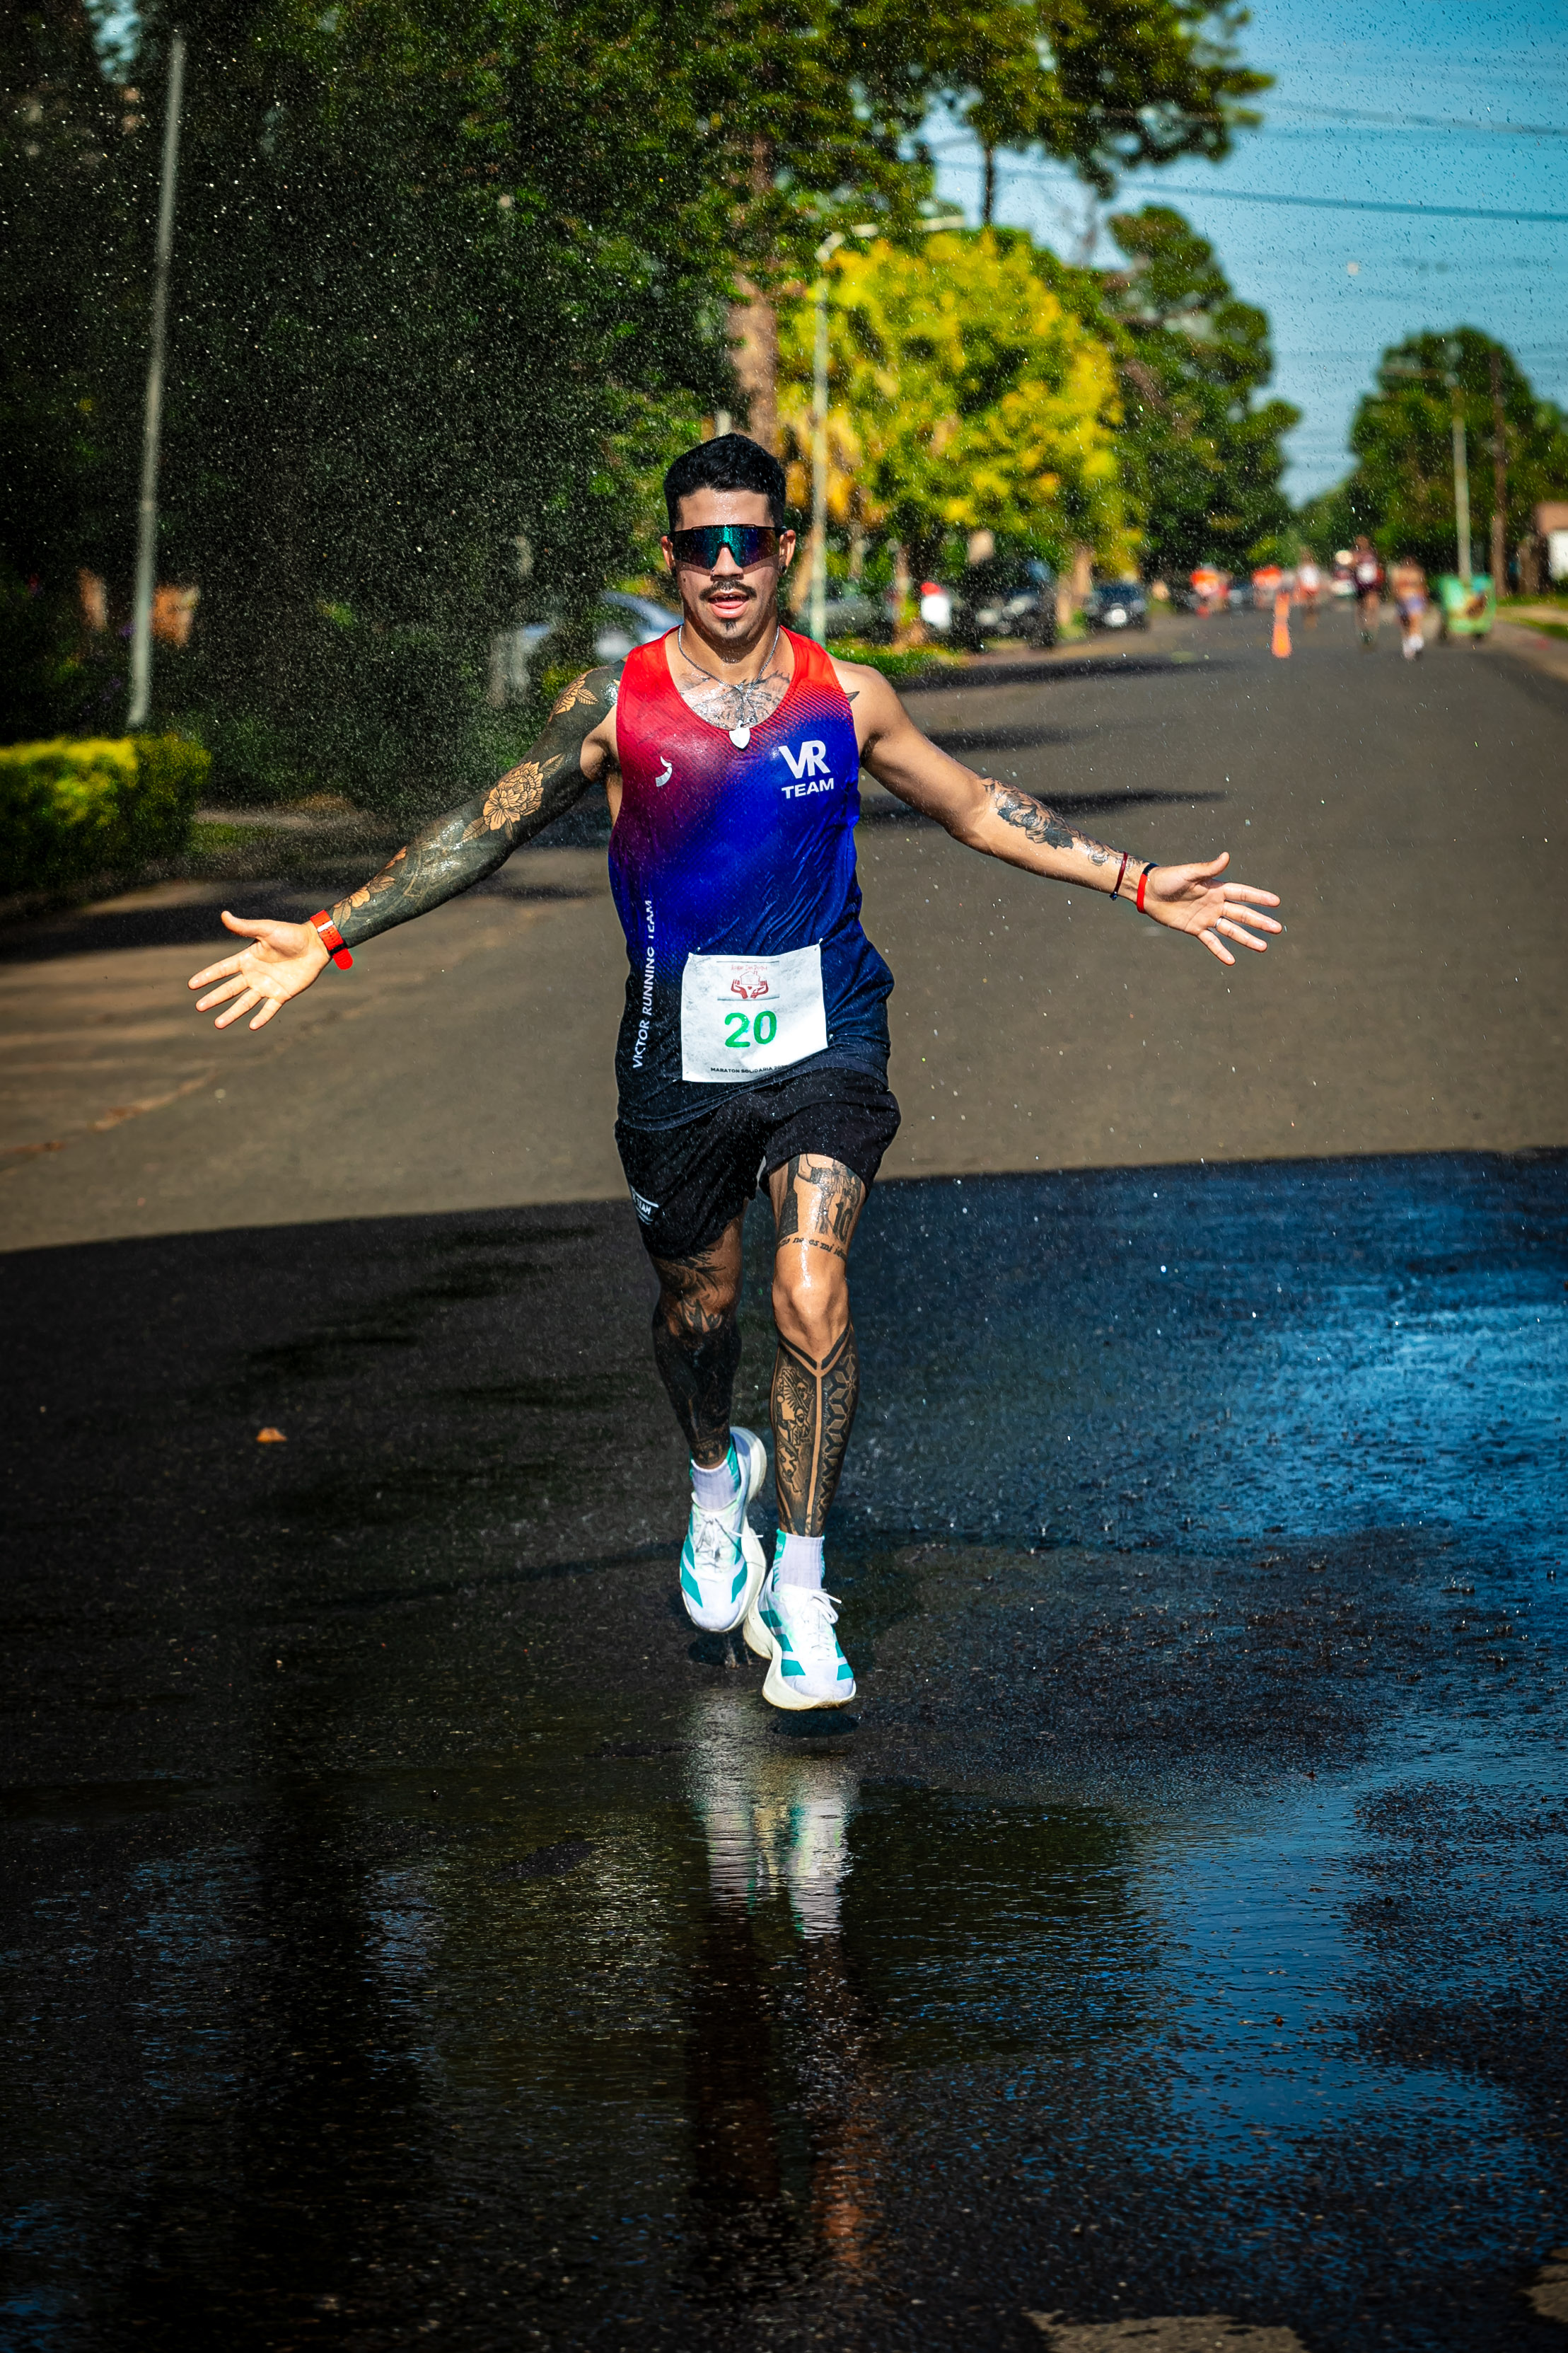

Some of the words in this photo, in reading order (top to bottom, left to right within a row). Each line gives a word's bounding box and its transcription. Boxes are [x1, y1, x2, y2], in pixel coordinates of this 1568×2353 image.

[778, 740, 831, 779] VR
[782, 777, 834, 799] TEAM
[633, 1019, 650, 1068] VICTOR
[724, 1010, 777, 1048] 20
[820, 1243, 835, 1252] mi
